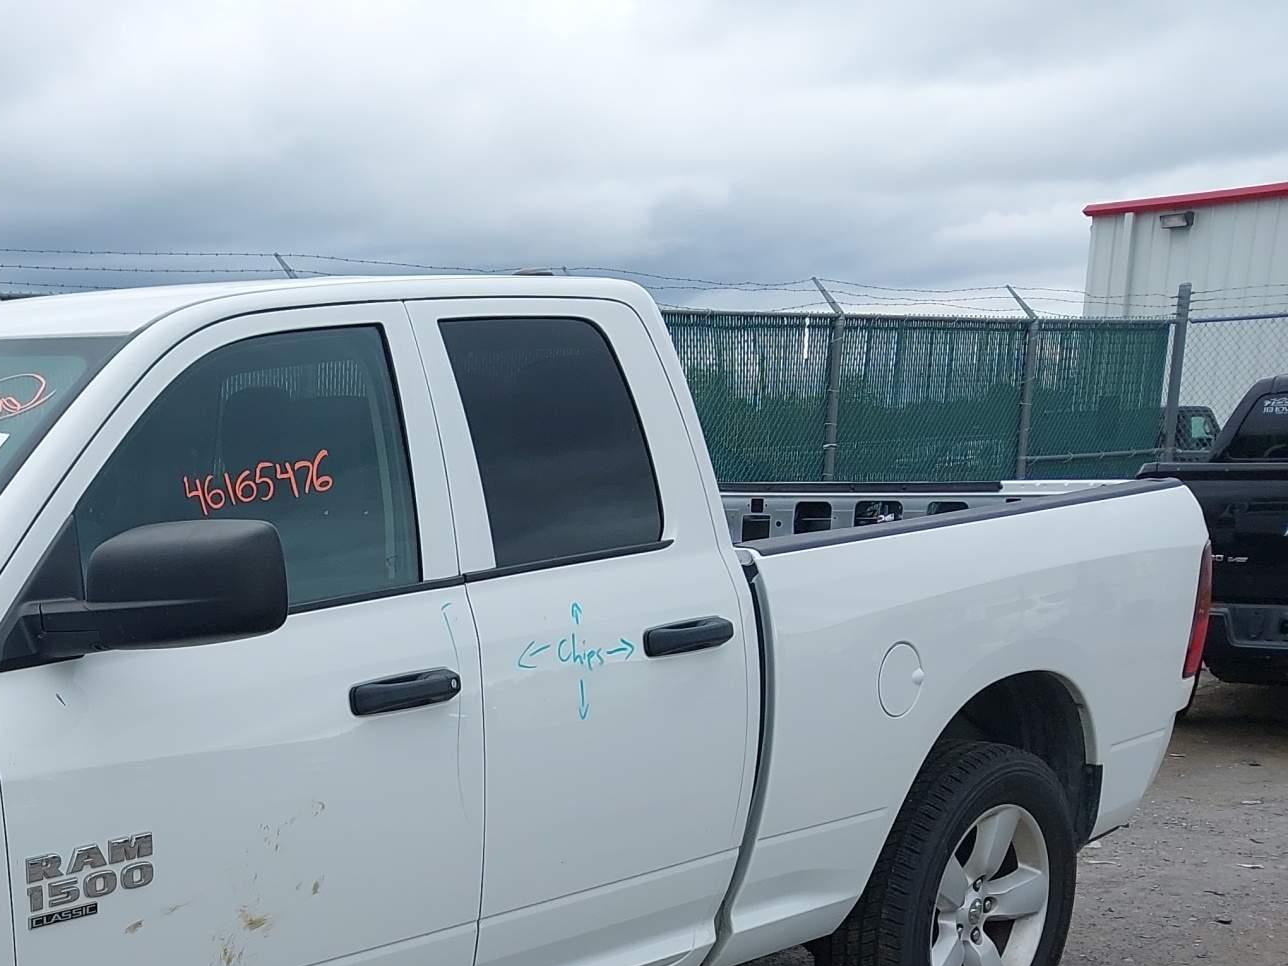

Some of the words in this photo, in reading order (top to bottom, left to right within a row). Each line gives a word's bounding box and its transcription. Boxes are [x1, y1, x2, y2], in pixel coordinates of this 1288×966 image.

[183, 449, 334, 516] 46165476
[25, 831, 154, 884] RAM
[27, 860, 154, 912] 1500
[31, 903, 98, 929] CLASSIC
